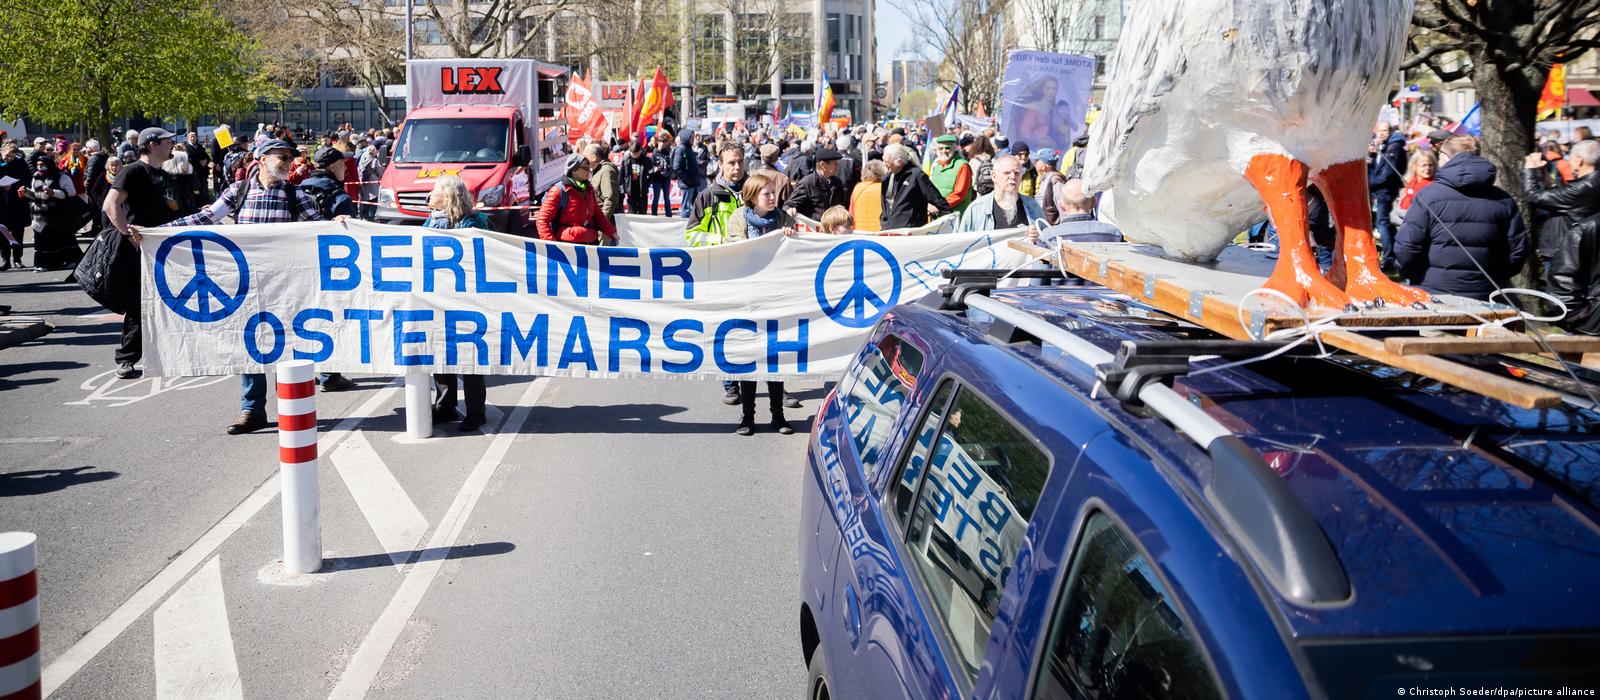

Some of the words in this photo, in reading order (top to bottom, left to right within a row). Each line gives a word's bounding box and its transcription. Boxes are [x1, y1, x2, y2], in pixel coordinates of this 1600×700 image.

[441, 66, 505, 94] LEX
[317, 234, 695, 301] BERLINER
[243, 308, 809, 374] OSTERMARSCH
